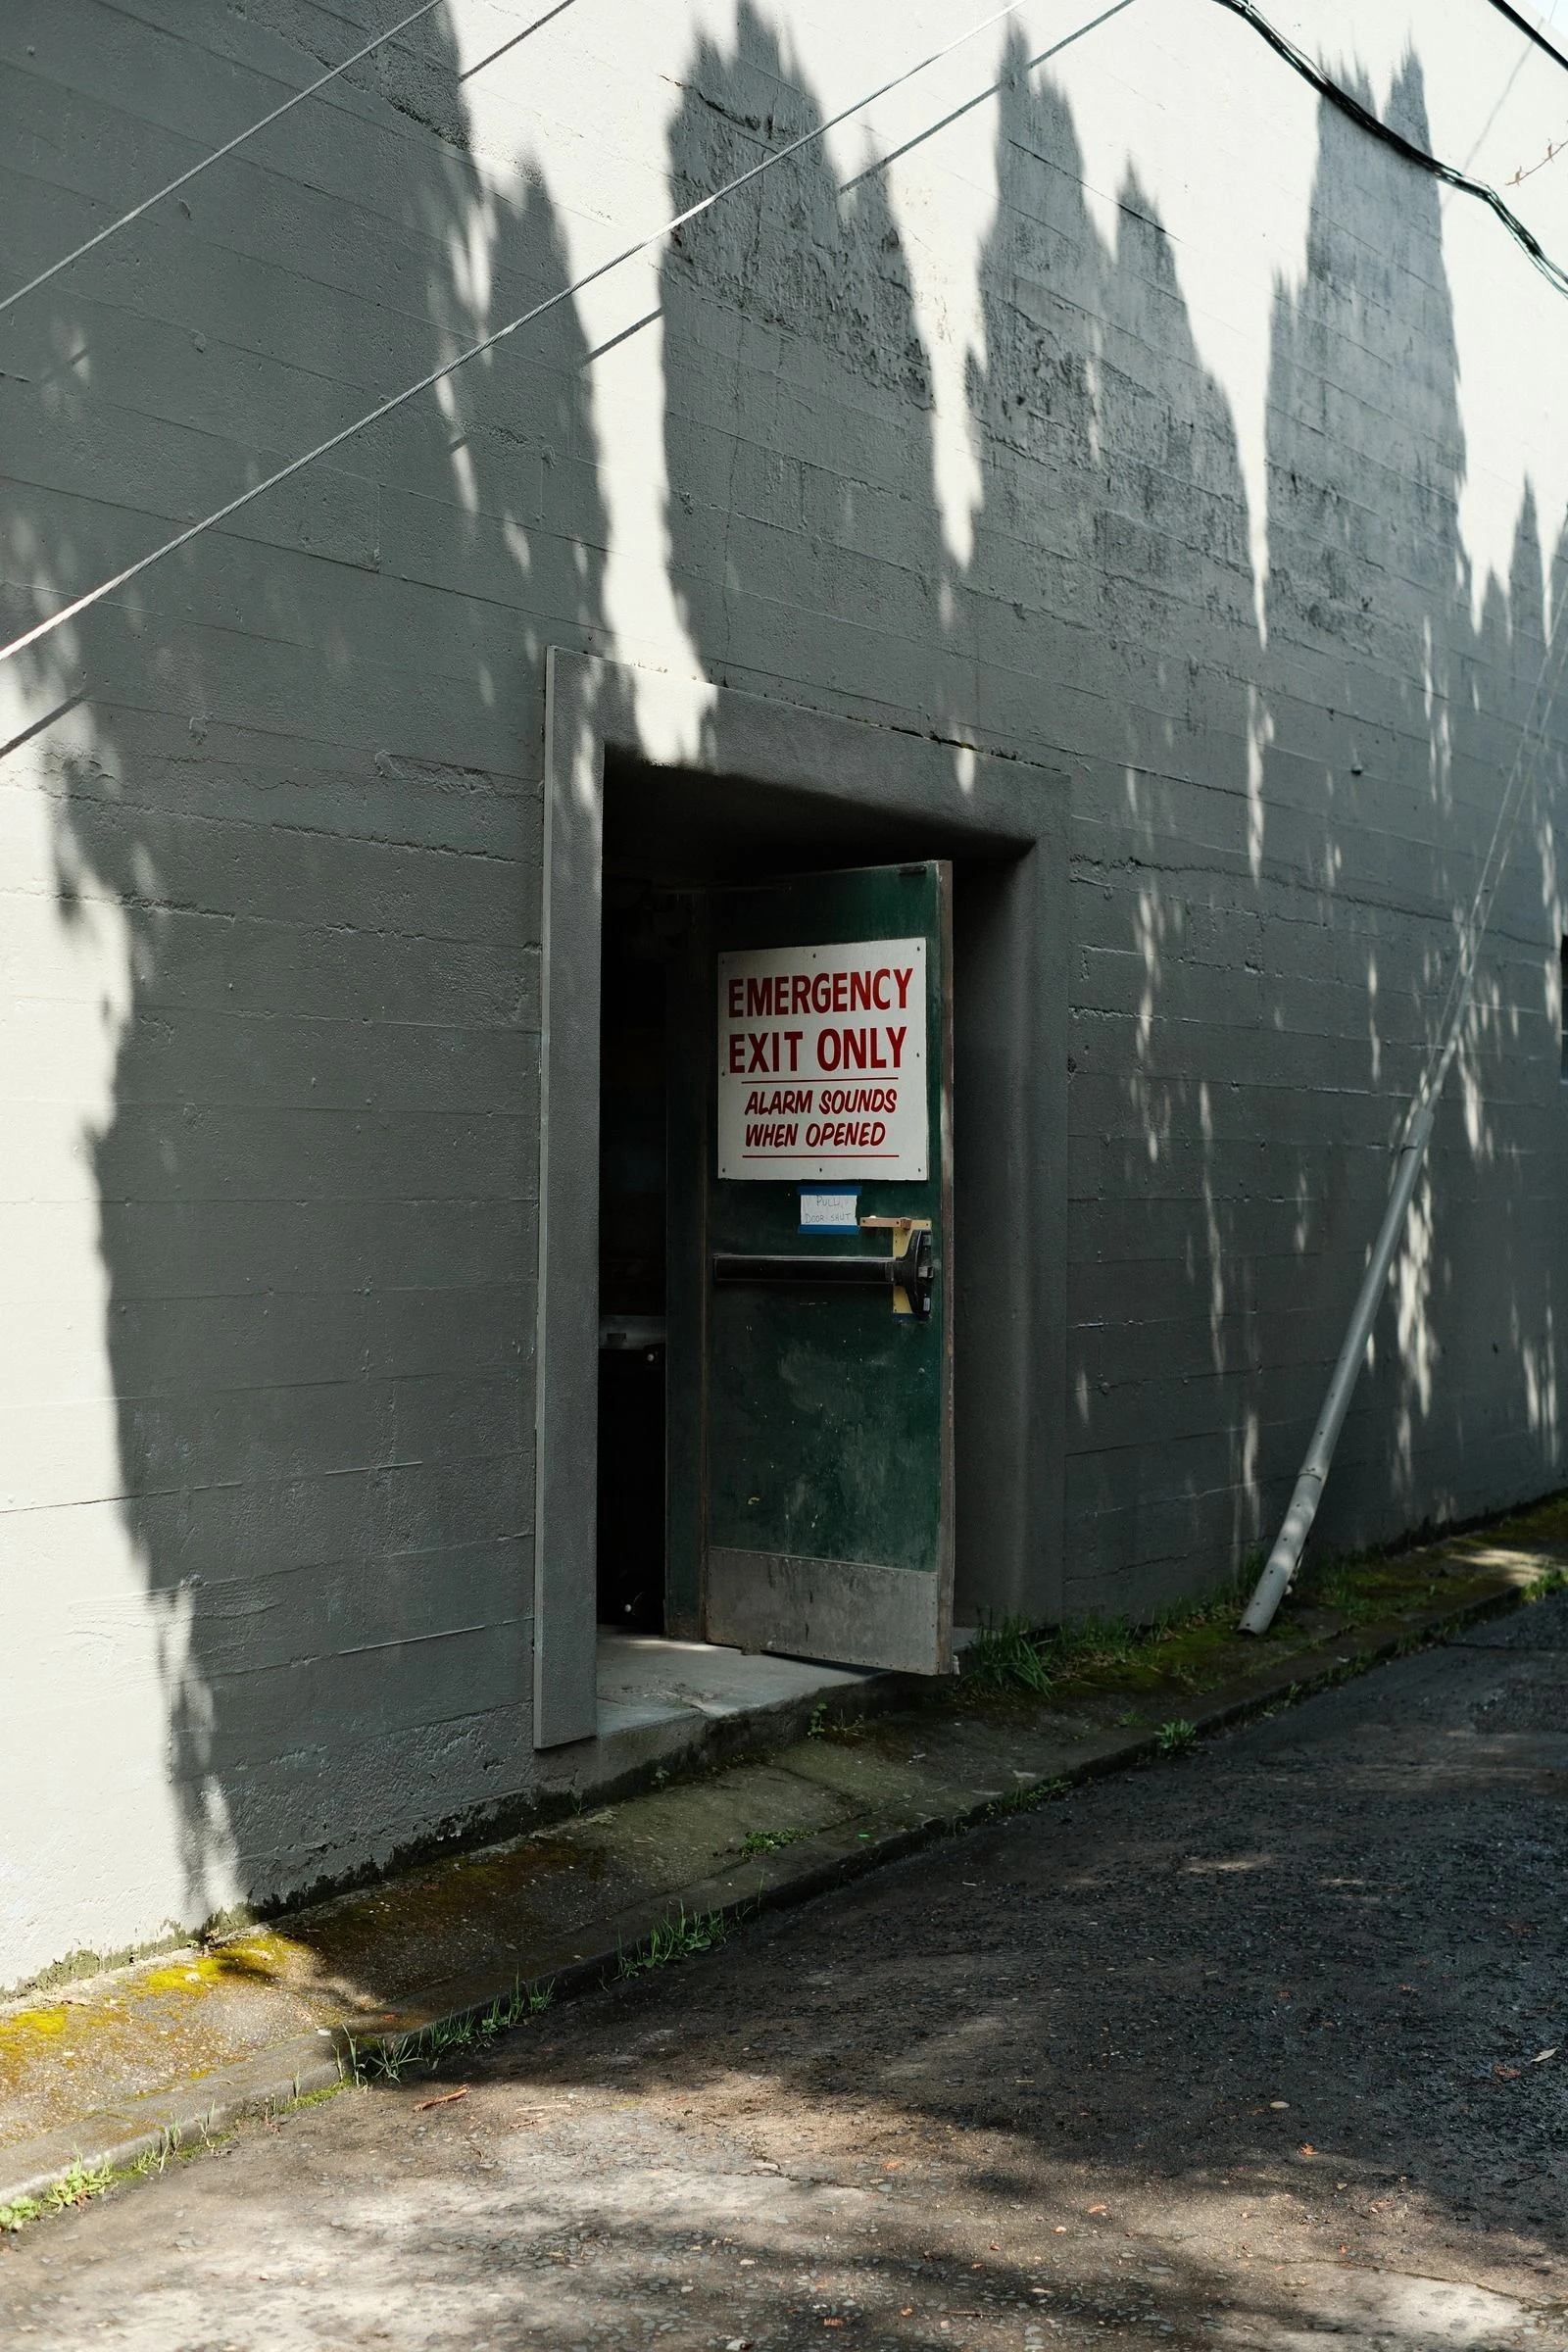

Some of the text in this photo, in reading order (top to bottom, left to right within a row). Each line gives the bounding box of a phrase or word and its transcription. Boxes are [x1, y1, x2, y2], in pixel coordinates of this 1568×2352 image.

[728, 967, 913, 1018] EMERGENCY
[729, 1026, 906, 1074] EXIT ONLY
[745, 1089, 897, 1115] ALARM SOUNDS
[746, 1122, 885, 1147] WHEN OPENED
[806, 1213, 852, 1224] DOOR SHUT
